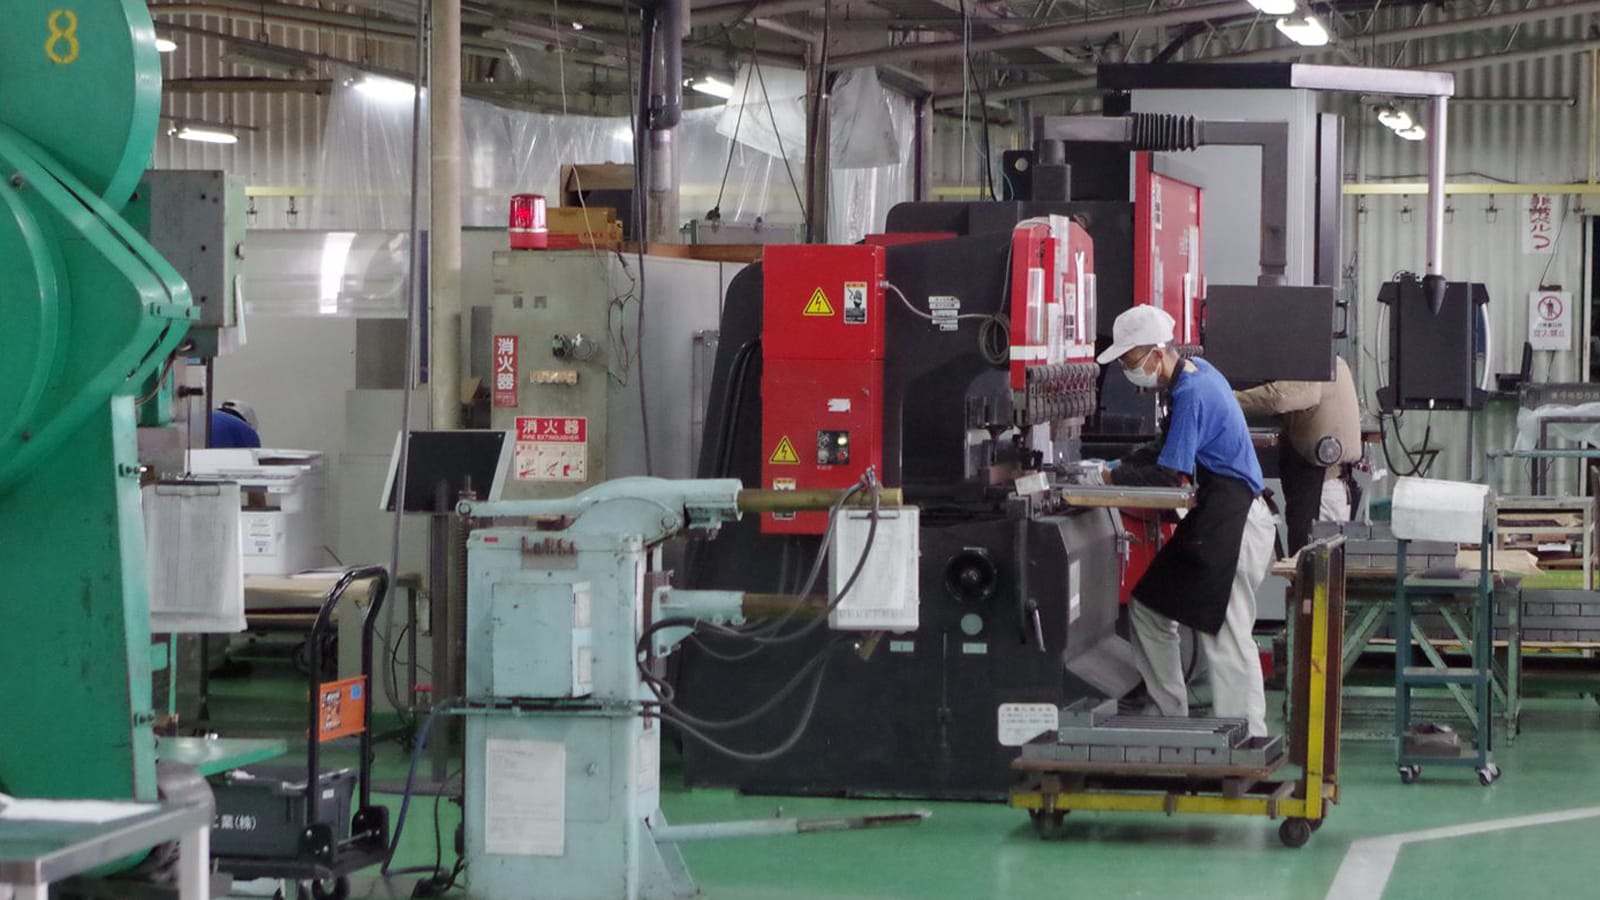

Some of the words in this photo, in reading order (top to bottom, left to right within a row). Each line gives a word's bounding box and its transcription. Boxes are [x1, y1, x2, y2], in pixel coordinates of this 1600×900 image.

[46, 9, 79, 64] 8
[497, 338, 514, 390] 消火器
[522, 420, 579, 434] 消火器
